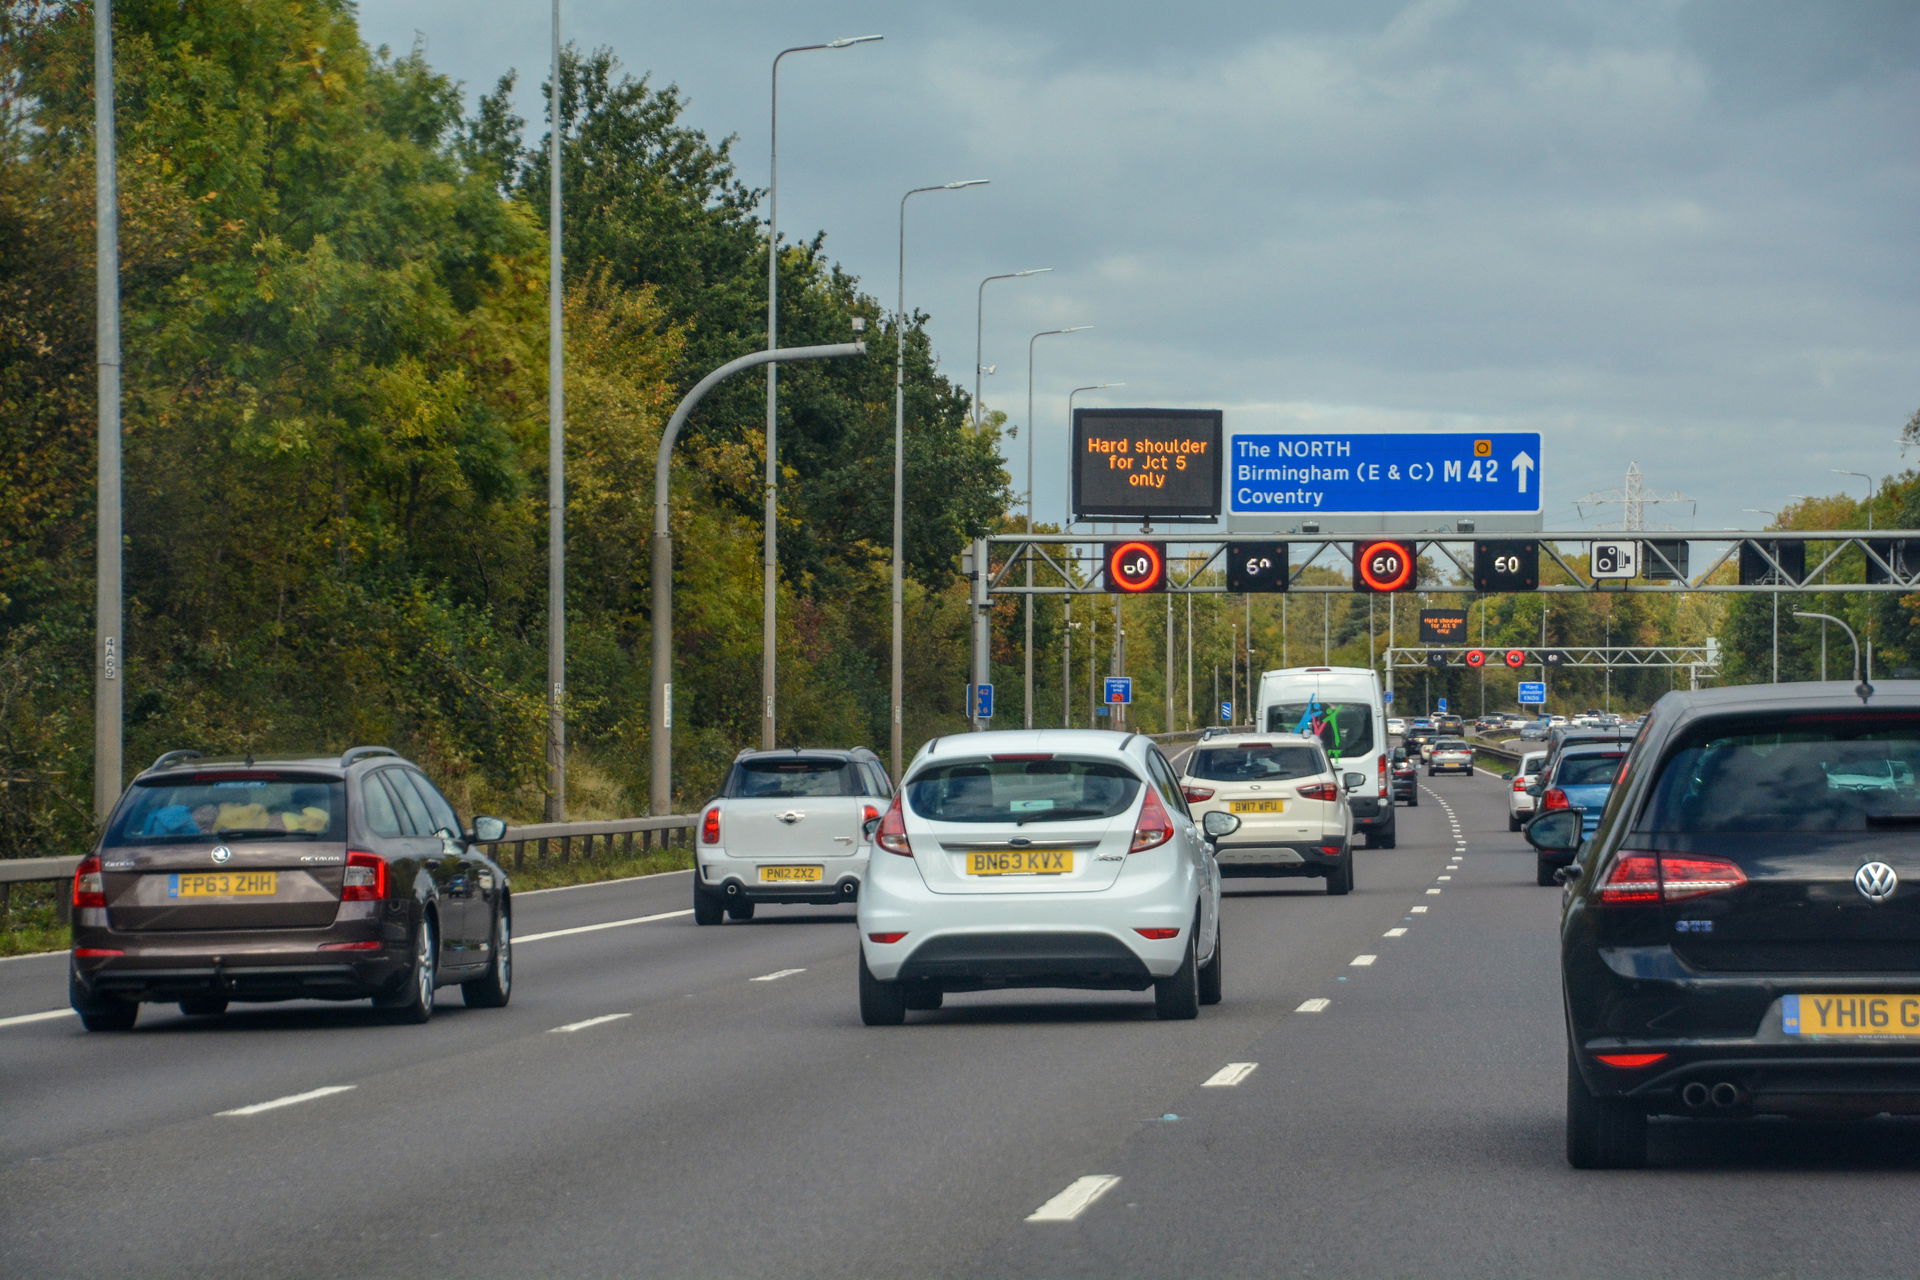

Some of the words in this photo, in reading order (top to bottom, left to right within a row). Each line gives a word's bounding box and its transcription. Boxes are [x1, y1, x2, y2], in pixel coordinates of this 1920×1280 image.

[1088, 438, 1128, 453] Hard
[1135, 438, 1207, 454] shoulder
[1237, 441, 1270, 457] The
[1278, 441, 1350, 457] NORTH
[1109, 454, 1134, 469] for
[1142, 455, 1168, 470] Jct
[1175, 455, 1187, 470] 5
[1129, 471, 1166, 488] only
[1238, 464, 1349, 484] Birmingham
[1356, 462, 1380, 482] (E
[1388, 464, 1400, 480] &
[1408, 462, 1434, 482] C)
[1237, 487, 1324, 507] Coventry
[1372, 556, 1397, 573] 60
[1494, 556, 1519, 573] 60
[974, 853, 1022, 871] BN63
[1028, 853, 1064, 869] KVX
[767, 868, 791, 879] PN12
[794, 868, 815, 878] ZXZ
[180, 876, 229, 894] FP63
[235, 874, 272, 892] ZHH
[1813, 998, 1889, 1027] YH16
